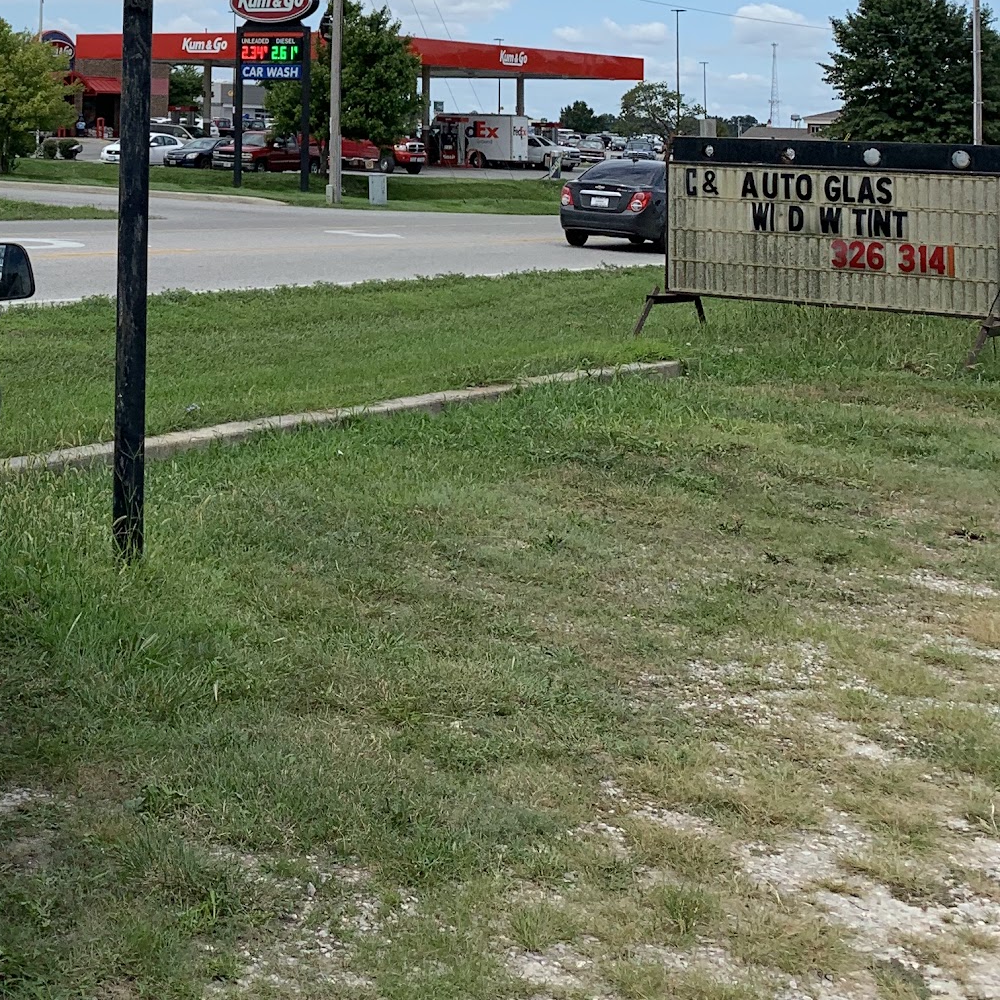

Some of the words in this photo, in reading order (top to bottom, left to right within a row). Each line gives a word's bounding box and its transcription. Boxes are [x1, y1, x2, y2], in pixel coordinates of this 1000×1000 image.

[242, 66, 264, 78] CAR
[266, 66, 299, 78] WASH
[465, 121, 499, 139] dEx
[741, 172, 813, 201] AUTO
[824, 175, 893, 205] GLAS
[852, 209, 908, 238] TINT
[831, 239, 885, 270] 326
